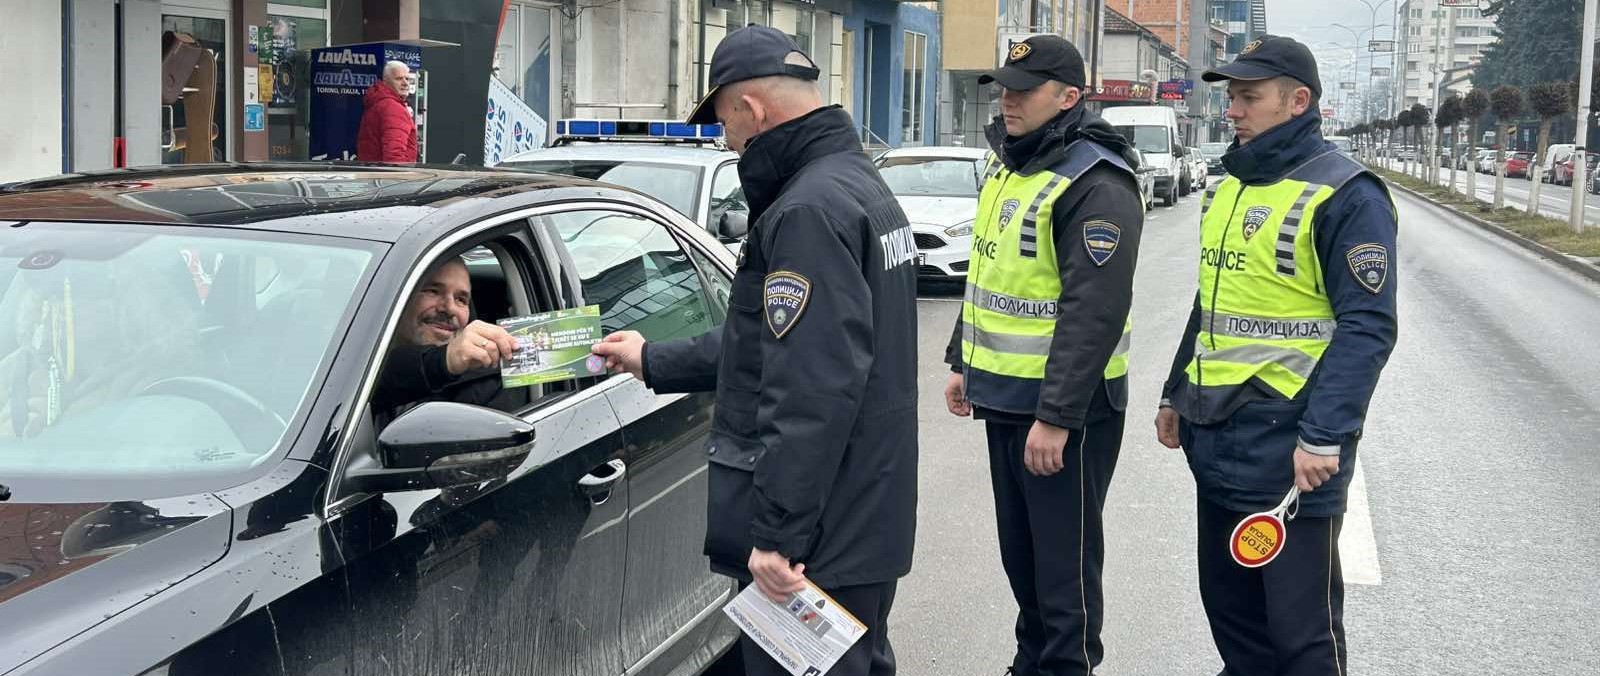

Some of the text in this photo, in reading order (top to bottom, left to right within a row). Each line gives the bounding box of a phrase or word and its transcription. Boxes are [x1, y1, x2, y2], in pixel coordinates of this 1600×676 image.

[318, 49, 376, 65] LAVAZZA
[314, 69, 377, 86] LAVAZZA
[1200, 247, 1247, 271] POLICE
[1351, 251, 1385, 265] ПОЛИЦИЈА
[1355, 261, 1385, 273] POLICE
[767, 285, 804, 299] ПОЛИЦИЈА
[767, 297, 799, 309] POLICE
[989, 295, 1058, 317] ПОЛИЦИЈ
[1228, 317, 1321, 337] ПОЛИЦИЈА
[1241, 535, 1268, 555] STOP
